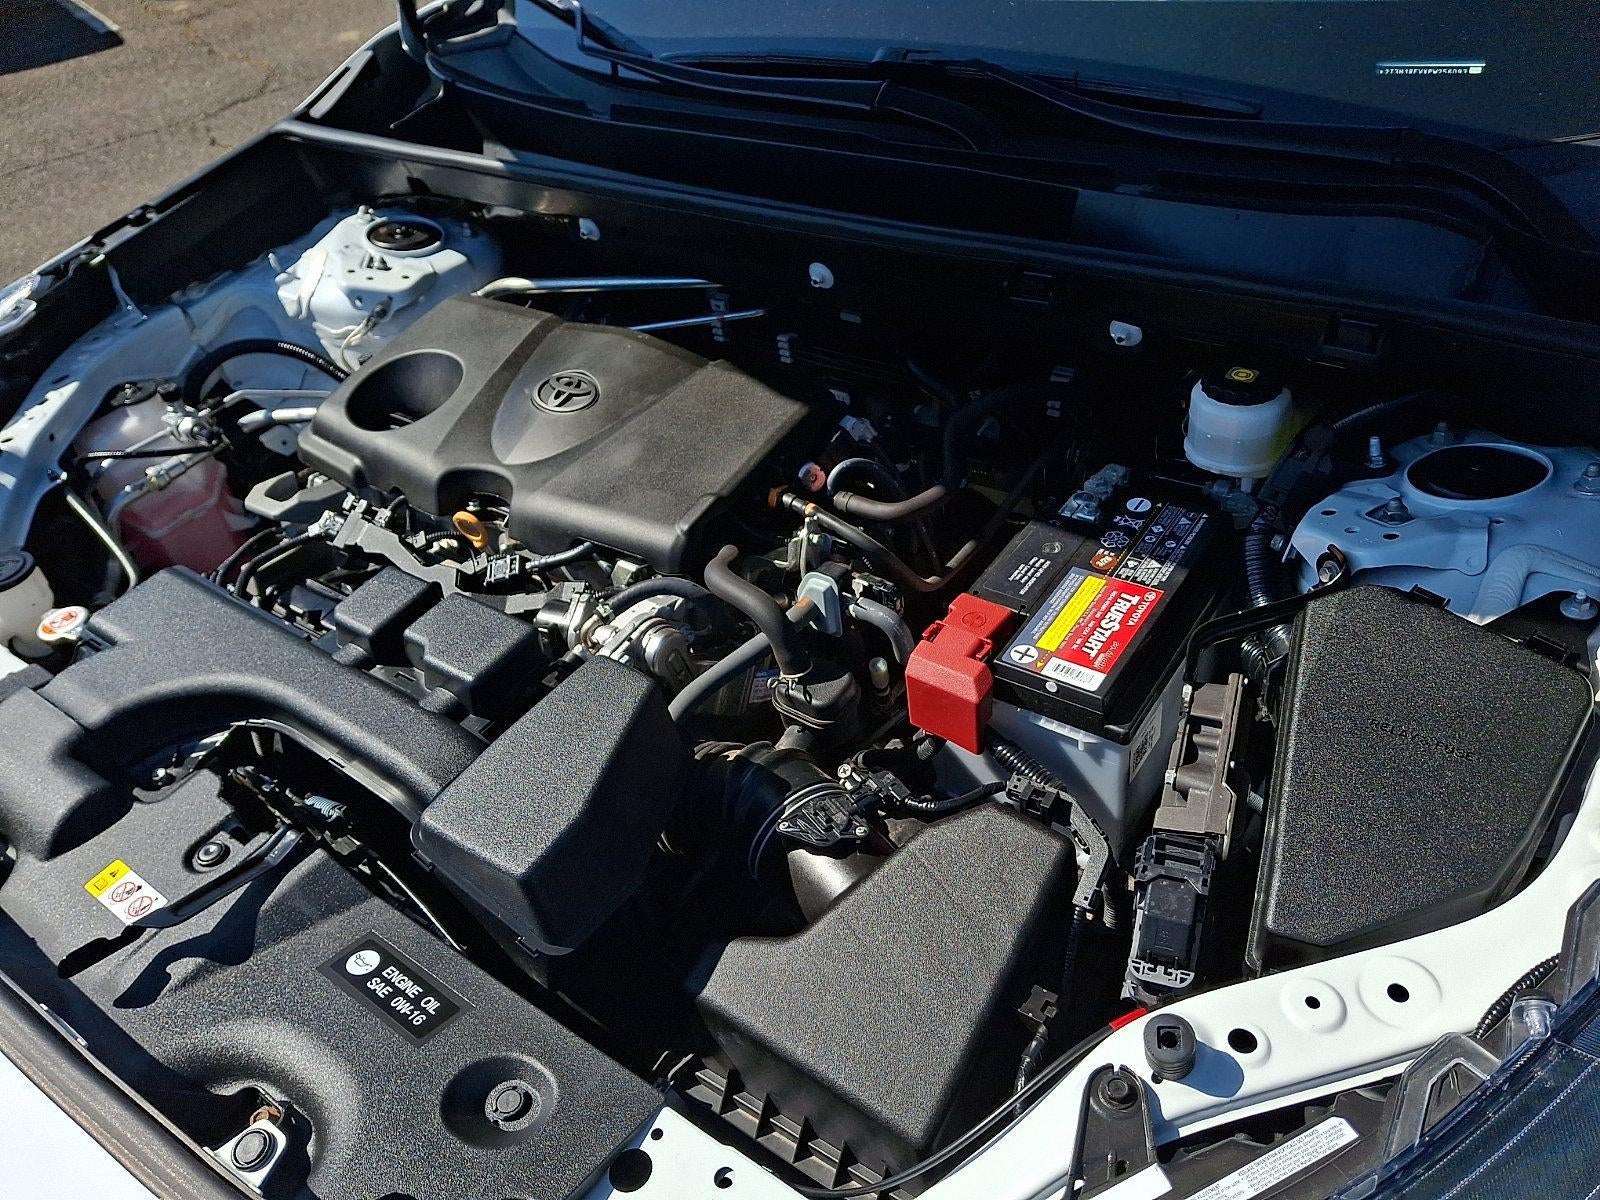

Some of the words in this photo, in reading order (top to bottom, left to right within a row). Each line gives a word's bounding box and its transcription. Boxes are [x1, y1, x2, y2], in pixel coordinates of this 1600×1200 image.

[1125, 601, 1150, 626] TOYOTA
[366, 976, 394, 999] SAE
[390, 996, 427, 1026] 0W-16
[381, 965, 424, 999] ENGINE
[420, 996, 441, 1016] OIL
